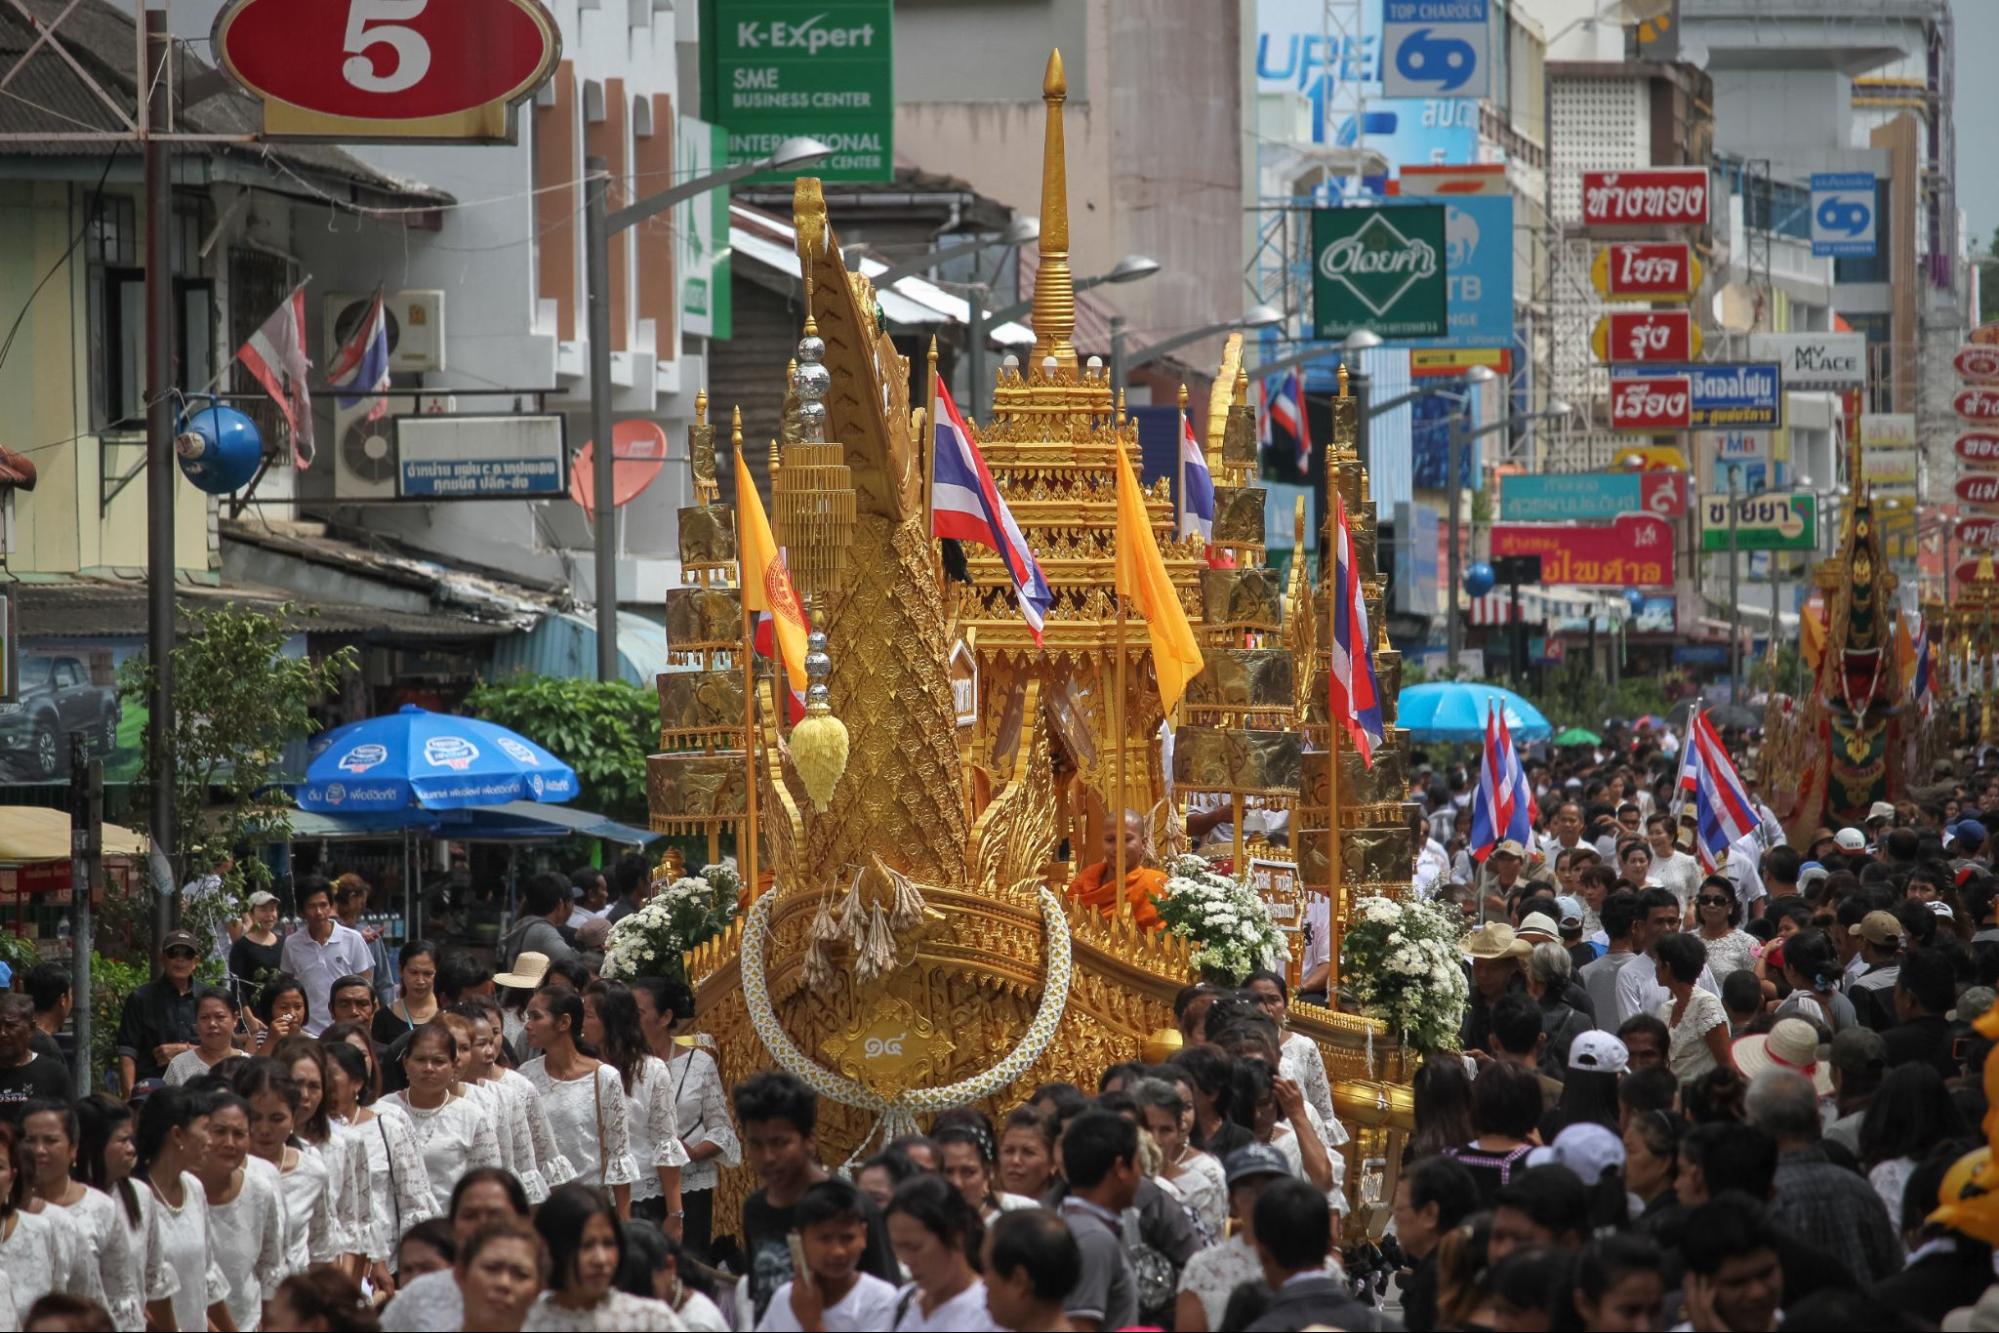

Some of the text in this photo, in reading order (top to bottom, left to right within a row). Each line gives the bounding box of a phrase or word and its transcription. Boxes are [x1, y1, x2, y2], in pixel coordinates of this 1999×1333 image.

[1390, 3, 1415, 19] TOP
[737, 11, 875, 55] K-Expert
[342, 0, 432, 94] 5
[733, 68, 779, 89] SME
[732, 92, 871, 109] BUSINESS CENTER
[729, 133, 882, 153] INTERTIONAL
[831, 155, 882, 170] CENTER
[1710, 501, 1789, 524] ขยยา
[864, 1032, 907, 1060] ๑๔
